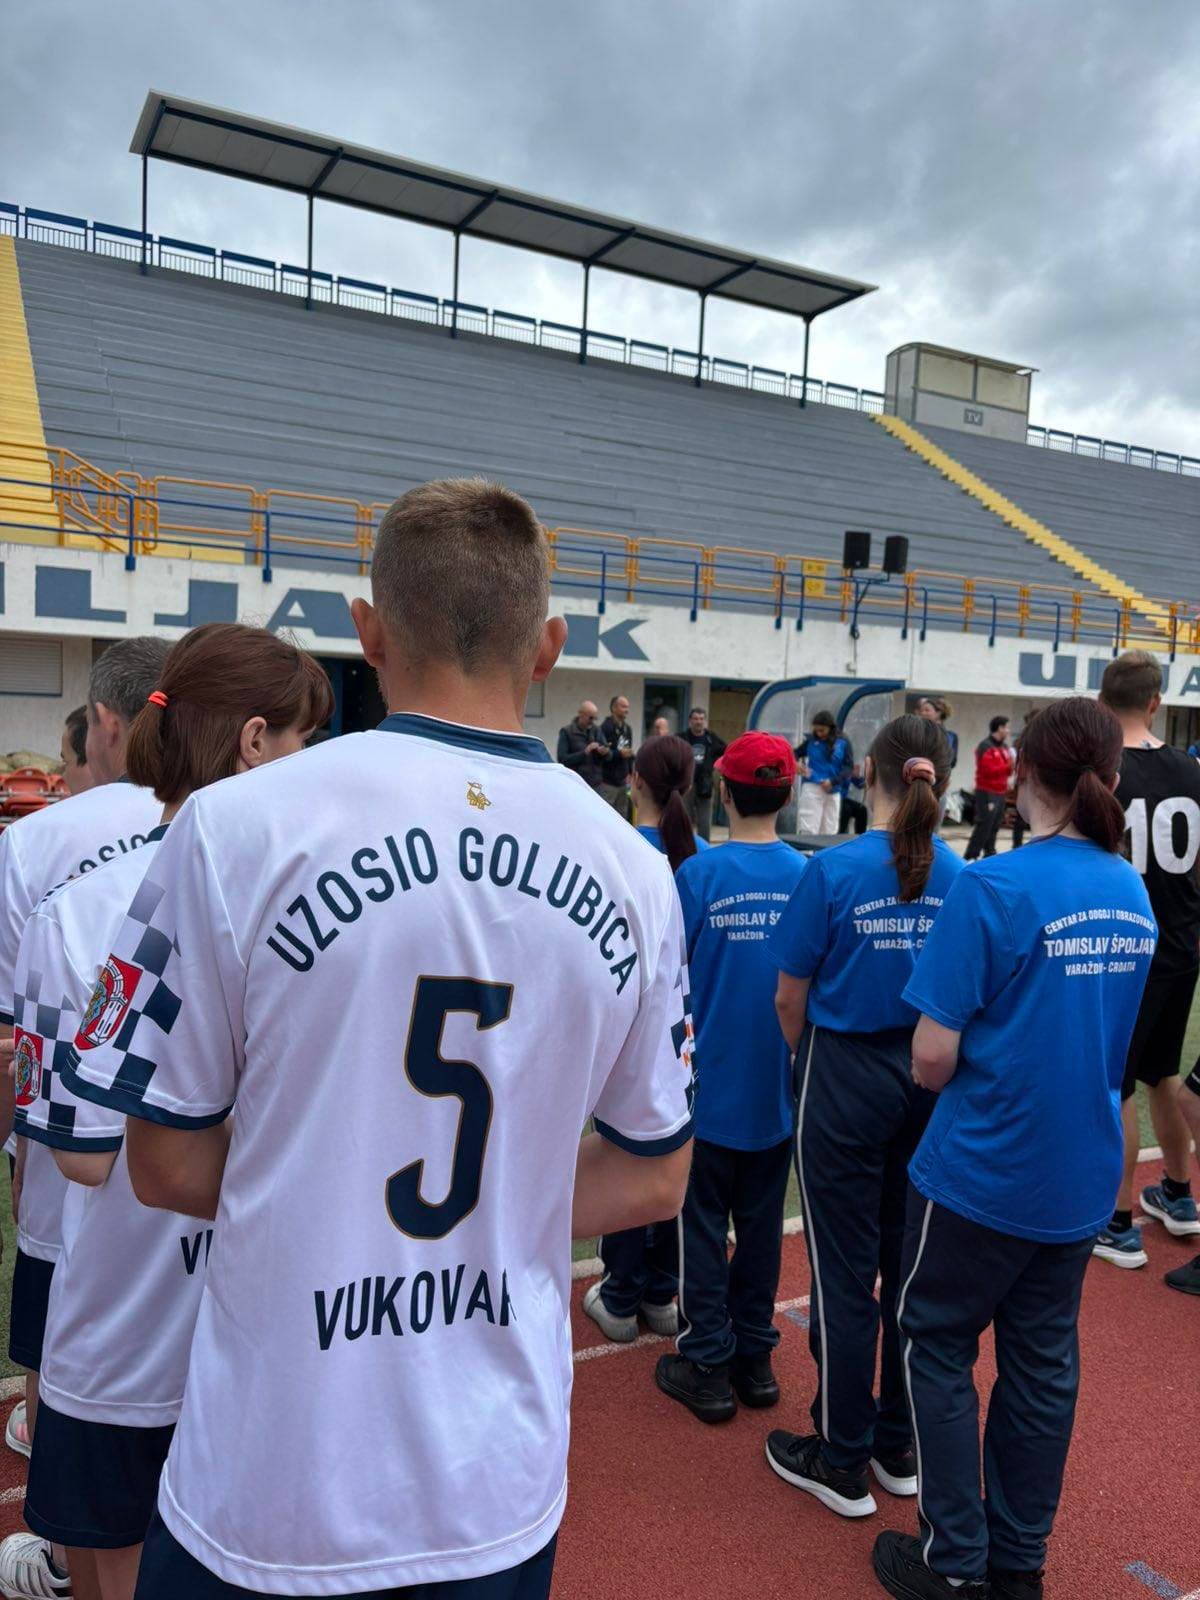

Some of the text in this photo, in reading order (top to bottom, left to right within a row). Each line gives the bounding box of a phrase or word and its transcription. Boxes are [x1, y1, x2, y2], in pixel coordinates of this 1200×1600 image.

[965, 411, 982, 424] TV
[1123, 796, 1200, 875] 10
[266, 827, 639, 996] UZOSIO GOLUBICA
[709, 895, 735, 912] CENTAR
[735, 893, 745, 903] ZA
[854, 898, 886, 916] CENTAR
[886, 896, 897, 906] ZA
[709, 911, 766, 929] TOMISLAV
[1044, 913, 1077, 935] CENTAR
[1077, 910, 1088, 922] ZA
[1088, 909, 1110, 920] ODGOJ
[1043, 933, 1155, 958] TOMISLAV ŠPOLJAR
[384, 974, 514, 1240] 5
